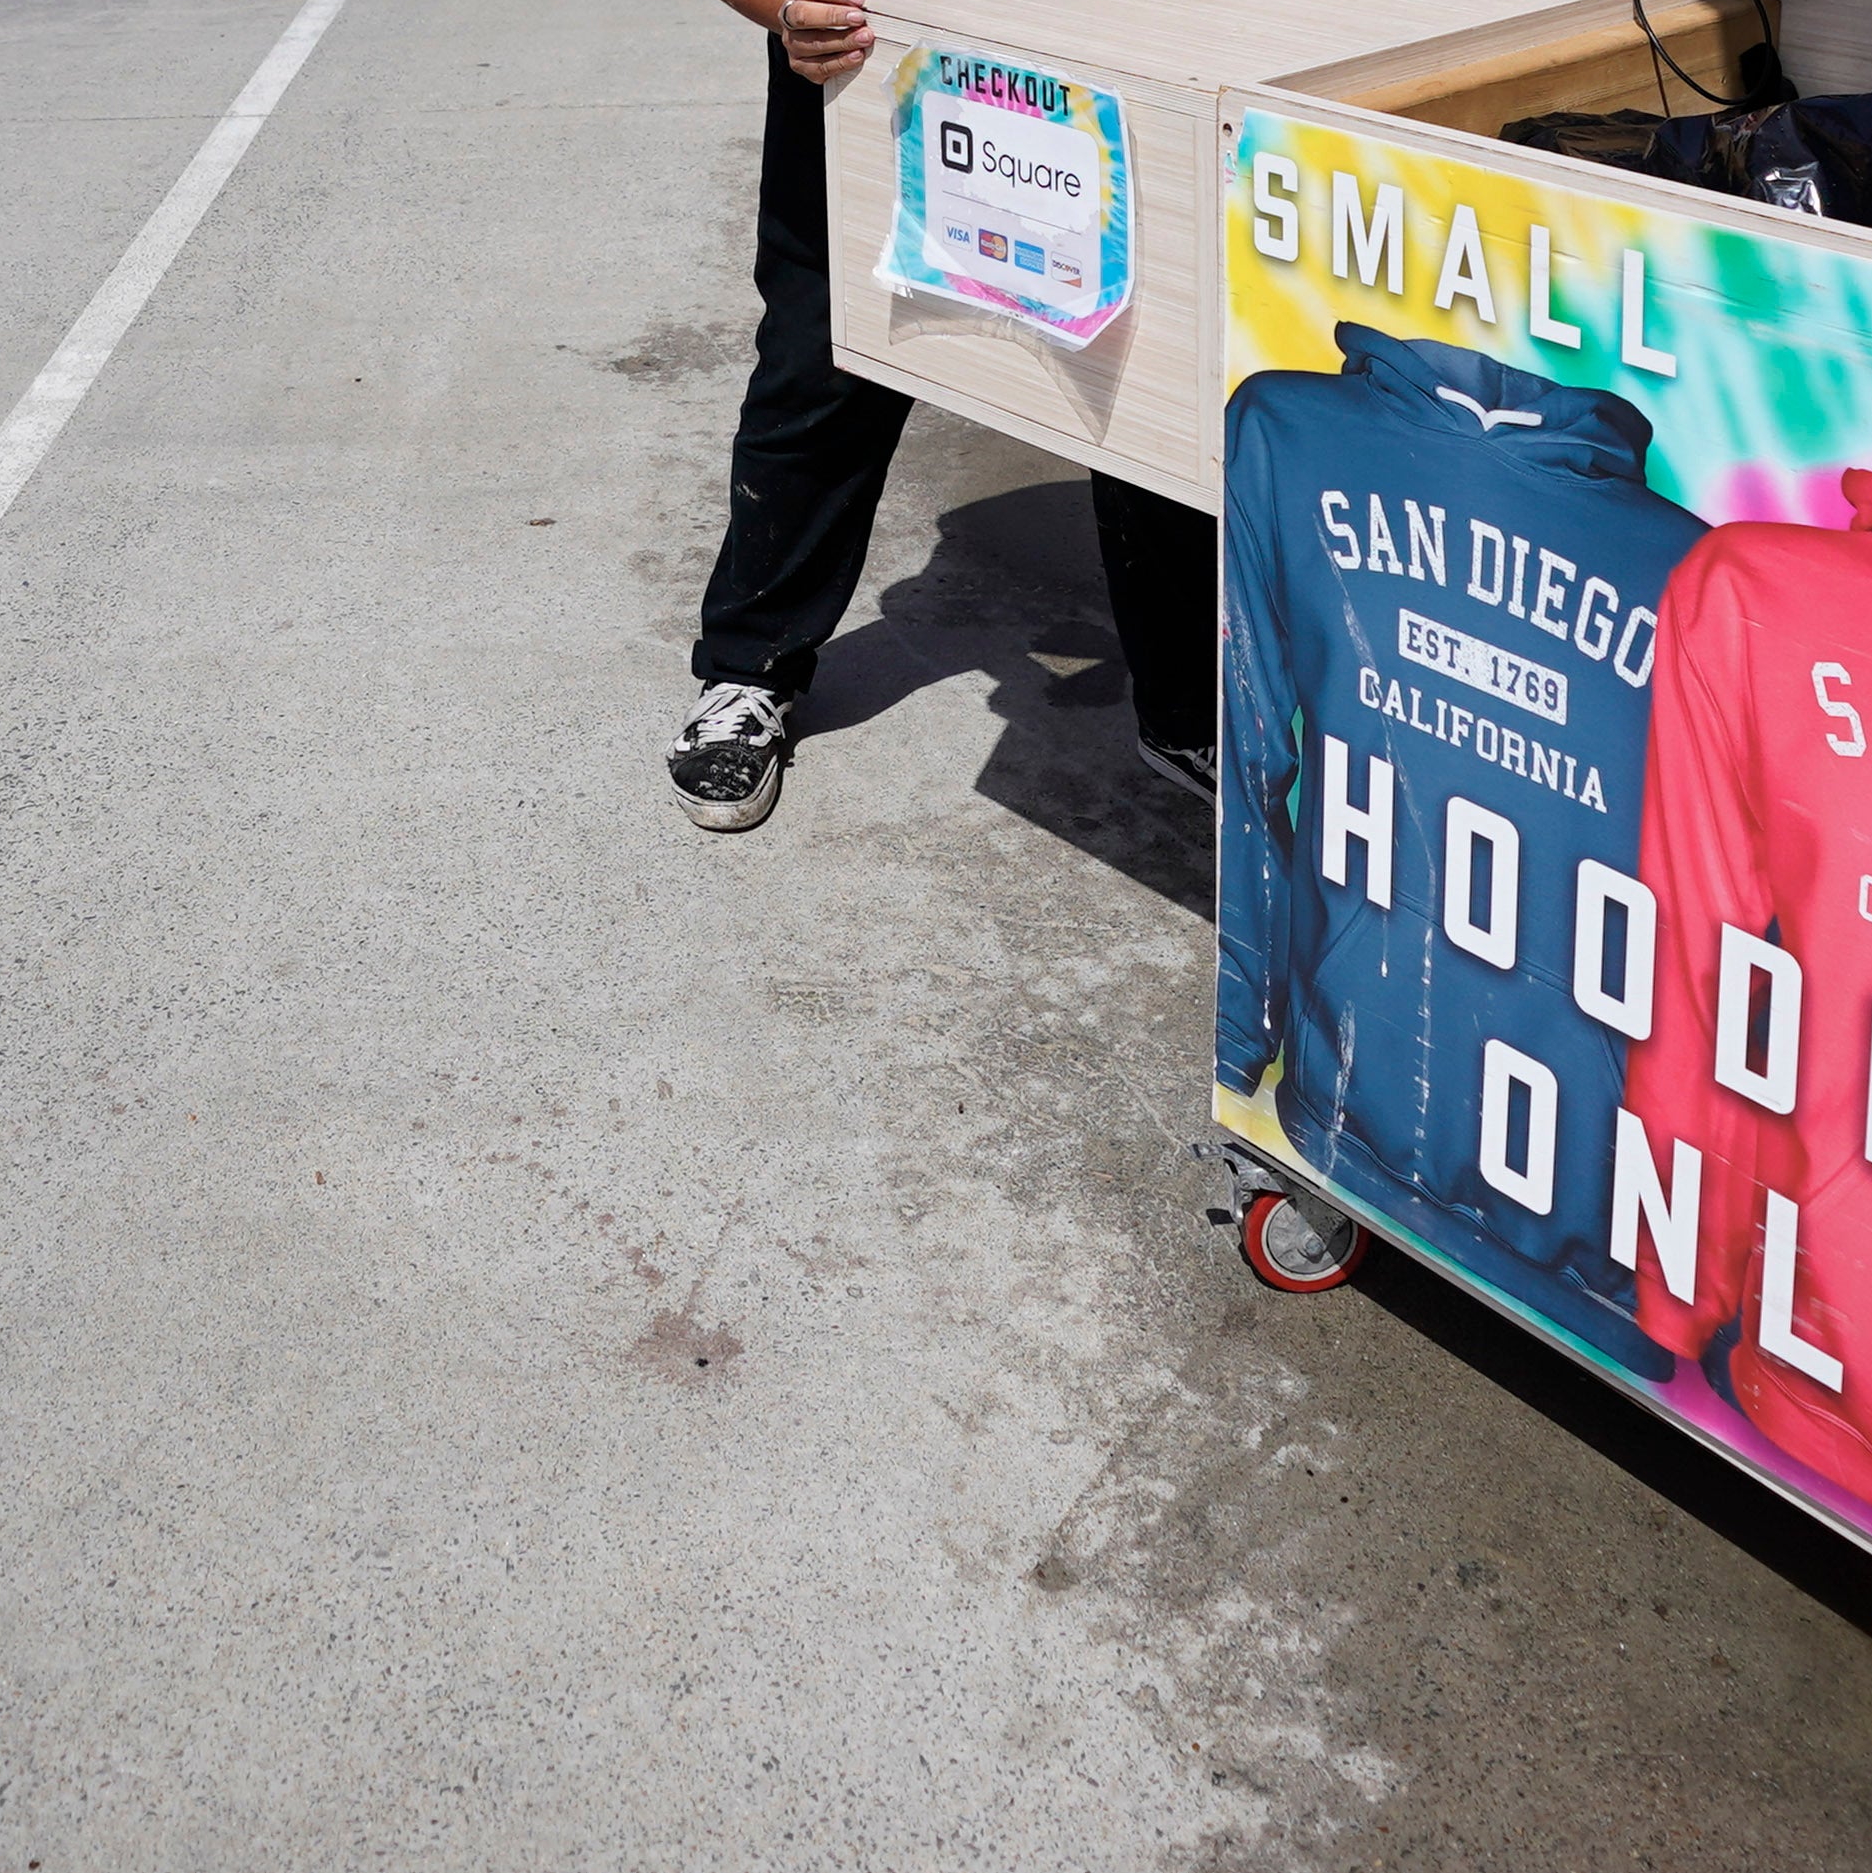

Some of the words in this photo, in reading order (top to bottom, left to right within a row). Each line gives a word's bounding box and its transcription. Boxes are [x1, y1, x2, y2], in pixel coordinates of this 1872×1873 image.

[939, 55, 1071, 116] CHECKOUT
[981, 140, 1082, 198] Square
[945, 225, 971, 244] VISA
[1252, 150, 1678, 379] SMALL
[1320, 489, 1448, 588] SAN
[1467, 518, 1659, 689] DIEGO
[1406, 619, 1471, 677] EST.
[1491, 655, 1559, 712] 1769
[1358, 665, 1608, 815] CALIFORNIA
